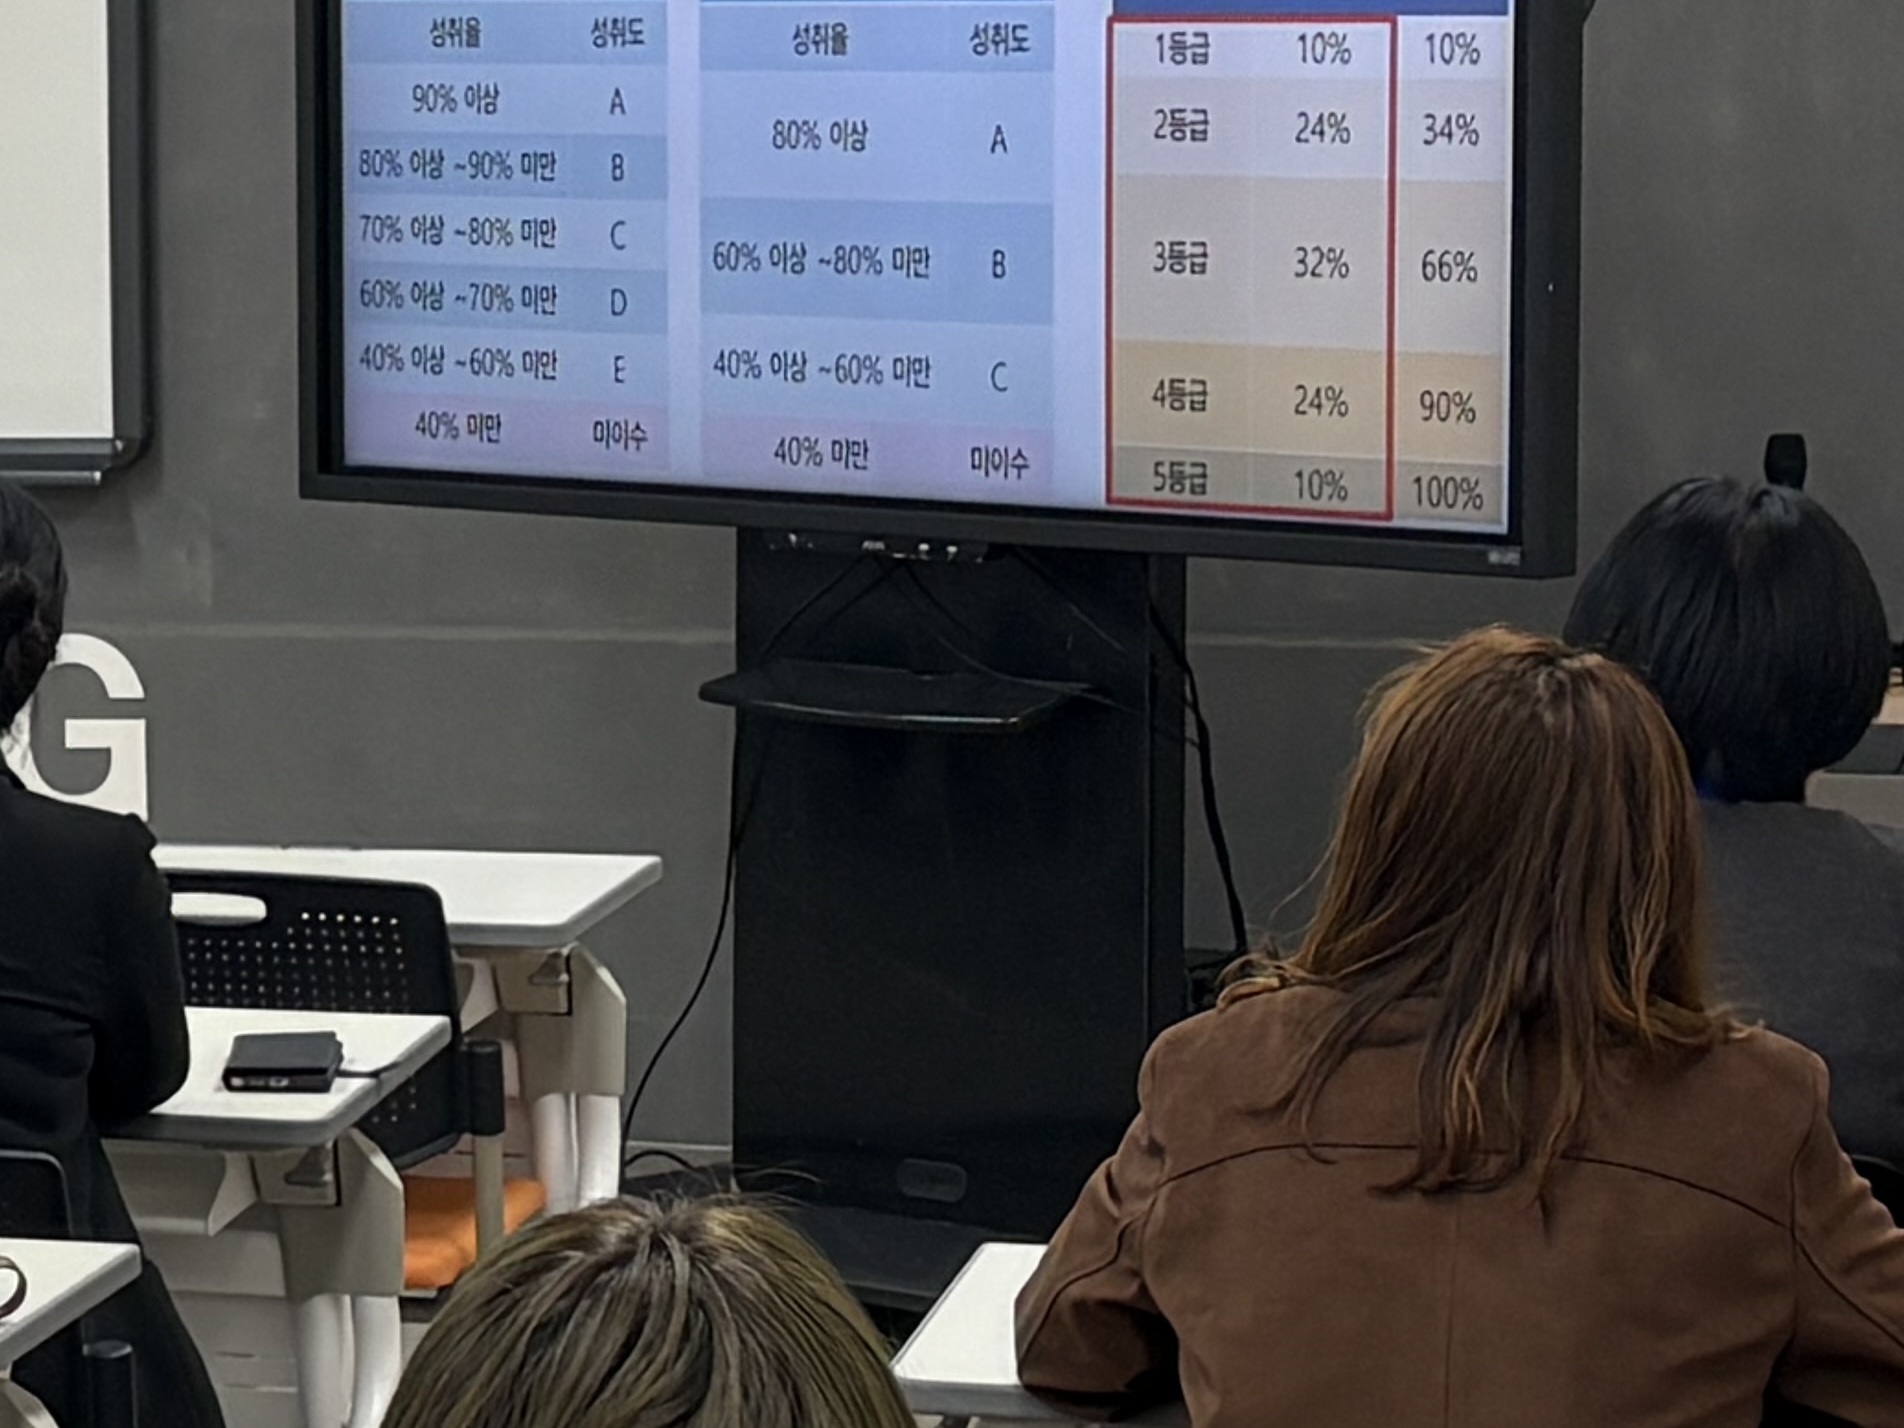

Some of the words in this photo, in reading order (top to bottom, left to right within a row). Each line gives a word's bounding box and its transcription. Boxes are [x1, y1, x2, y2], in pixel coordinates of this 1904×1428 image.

[591, 17, 644, 48] 성취도
[970, 23, 1030, 56] 성취도
[1157, 32, 1210, 65] 1등급
[1298, 32, 1351, 65] 10%
[1426, 32, 1480, 65] 10%
[413, 84, 457, 113] 90%
[464, 83, 499, 115] 이상
[610, 88, 626, 115] A
[773, 120, 821, 150] 80%
[830, 120, 868, 152] 이상
[991, 125, 1007, 153] A
[1154, 108, 1209, 142] 2등급
[1295, 112, 1350, 144] 24%
[1423, 113, 1479, 146] 34%
[359, 149, 403, 177] 80%
[410, 149, 444, 180] 이상
[521, 152, 556, 181] 미만
[612, 153, 624, 181] B
[713, 241, 761, 271] 60%
[769, 242, 806, 274] 이상
[893, 246, 930, 278] 미만
[993, 249, 1005, 278] B
[1154, 241, 1208, 274] 3등급
[1295, 246, 1349, 278] 32%
[1422, 250, 1477, 282] 66%
[359, 343, 404, 372] 40%
[411, 345, 444, 375] 이상
[522, 350, 557, 380] 미만
[613, 355, 625, 384] E
[714, 349, 762, 379] 40%
[770, 351, 807, 383] 이상
[893, 356, 930, 389] 미만
[991, 362, 1007, 392] C
[1152, 378, 1207, 412] 4등급
[1295, 385, 1348, 417] 24%
[1420, 390, 1476, 424] 90%
[415, 411, 459, 440] 40%
[467, 413, 501, 444] 미만
[593, 420, 648, 451] 미이수
[774, 436, 823, 467] 40%
[832, 439, 868, 470] 미만
[971, 447, 1029, 479] 미이수
[1154, 461, 1207, 495] 5등급
[1295, 469, 1348, 502] 10%
[1414, 476, 1483, 510] 100%
